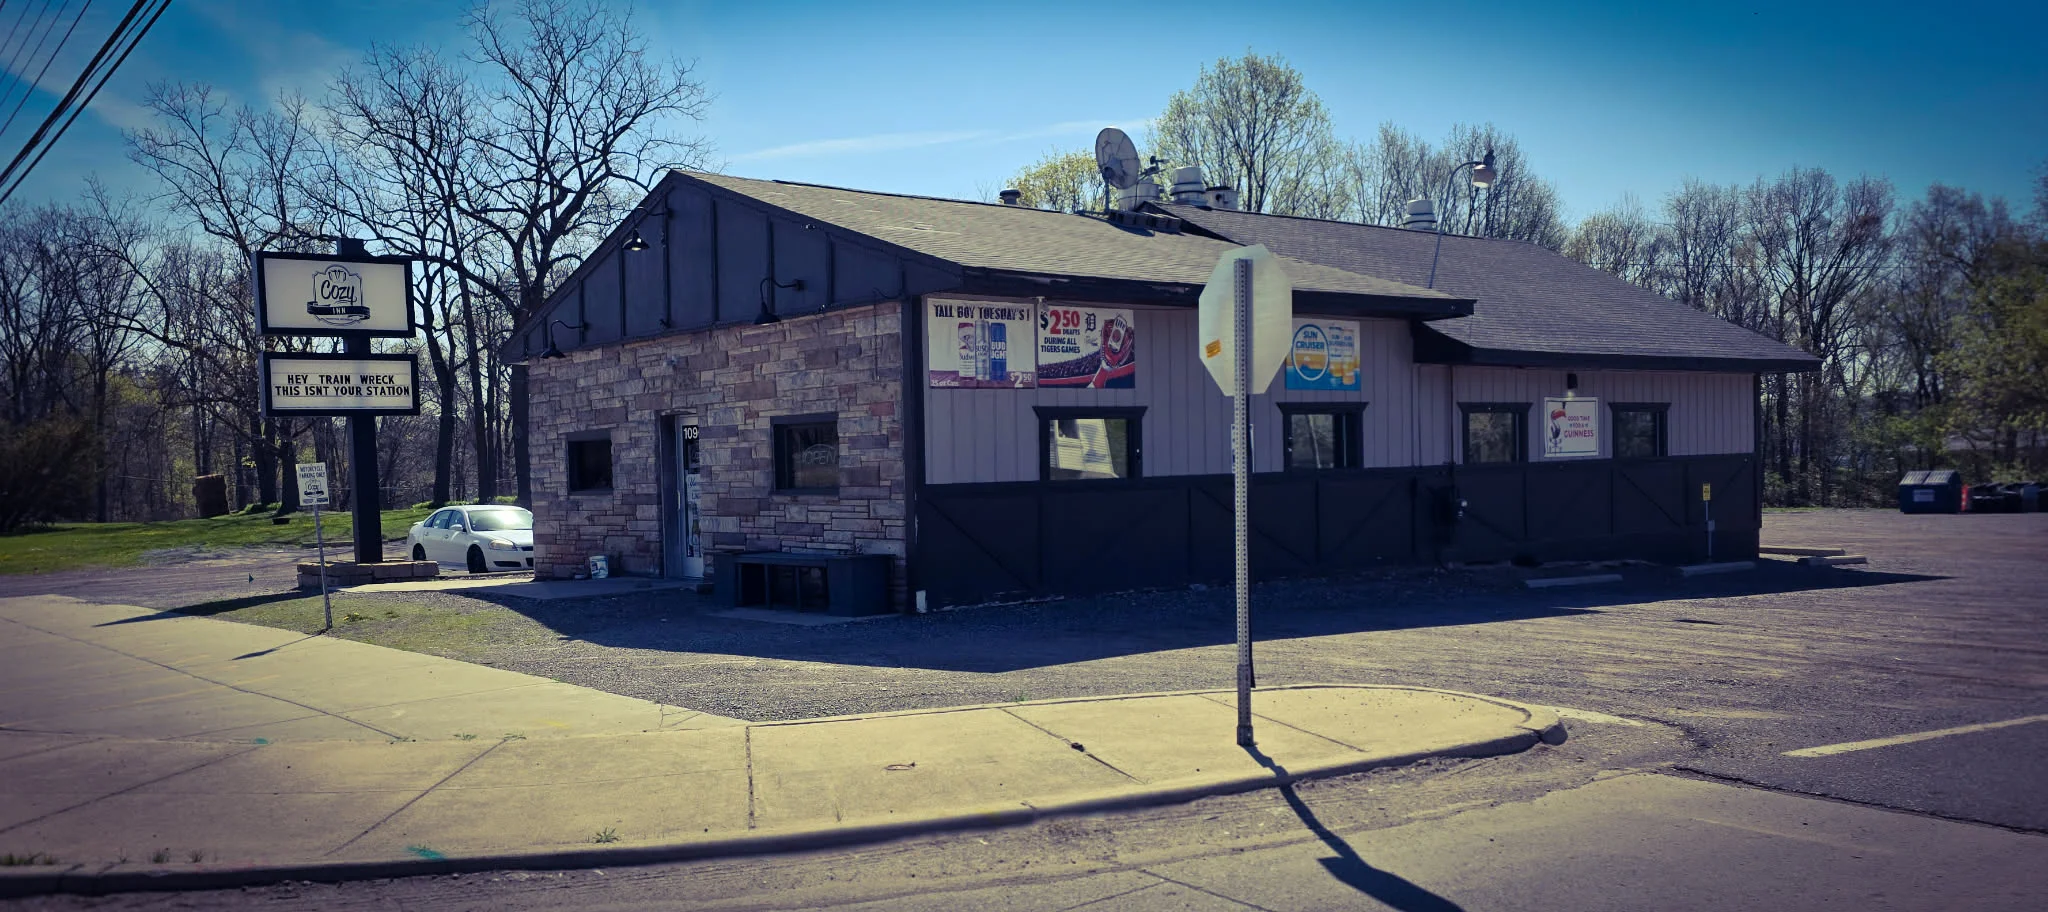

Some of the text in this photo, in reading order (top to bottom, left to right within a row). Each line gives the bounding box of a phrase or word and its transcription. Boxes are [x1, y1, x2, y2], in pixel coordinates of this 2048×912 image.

[320, 280, 358, 306] Cozy
[332, 307, 346, 315] INN
[934, 304, 954, 318] TALL
[957, 305, 975, 319] BOY
[978, 306, 1025, 321] TUESDAY'S
[1303, 330, 1318, 339] SUN
[1044, 336, 1066, 345] DURING
[1066, 337, 1077, 346] ALL
[1295, 341, 1325, 349] CRUISER
[1041, 345, 1081, 354] TIGERS GAMES
[287, 374, 395, 385] HEY TRAIN WRECK
[275, 385, 410, 396] THIS ISNT YOUR STATION
[683, 426, 699, 440] 109
[1564, 430, 1593, 438] GUINNESS
[804, 450, 837, 465] OPEN
